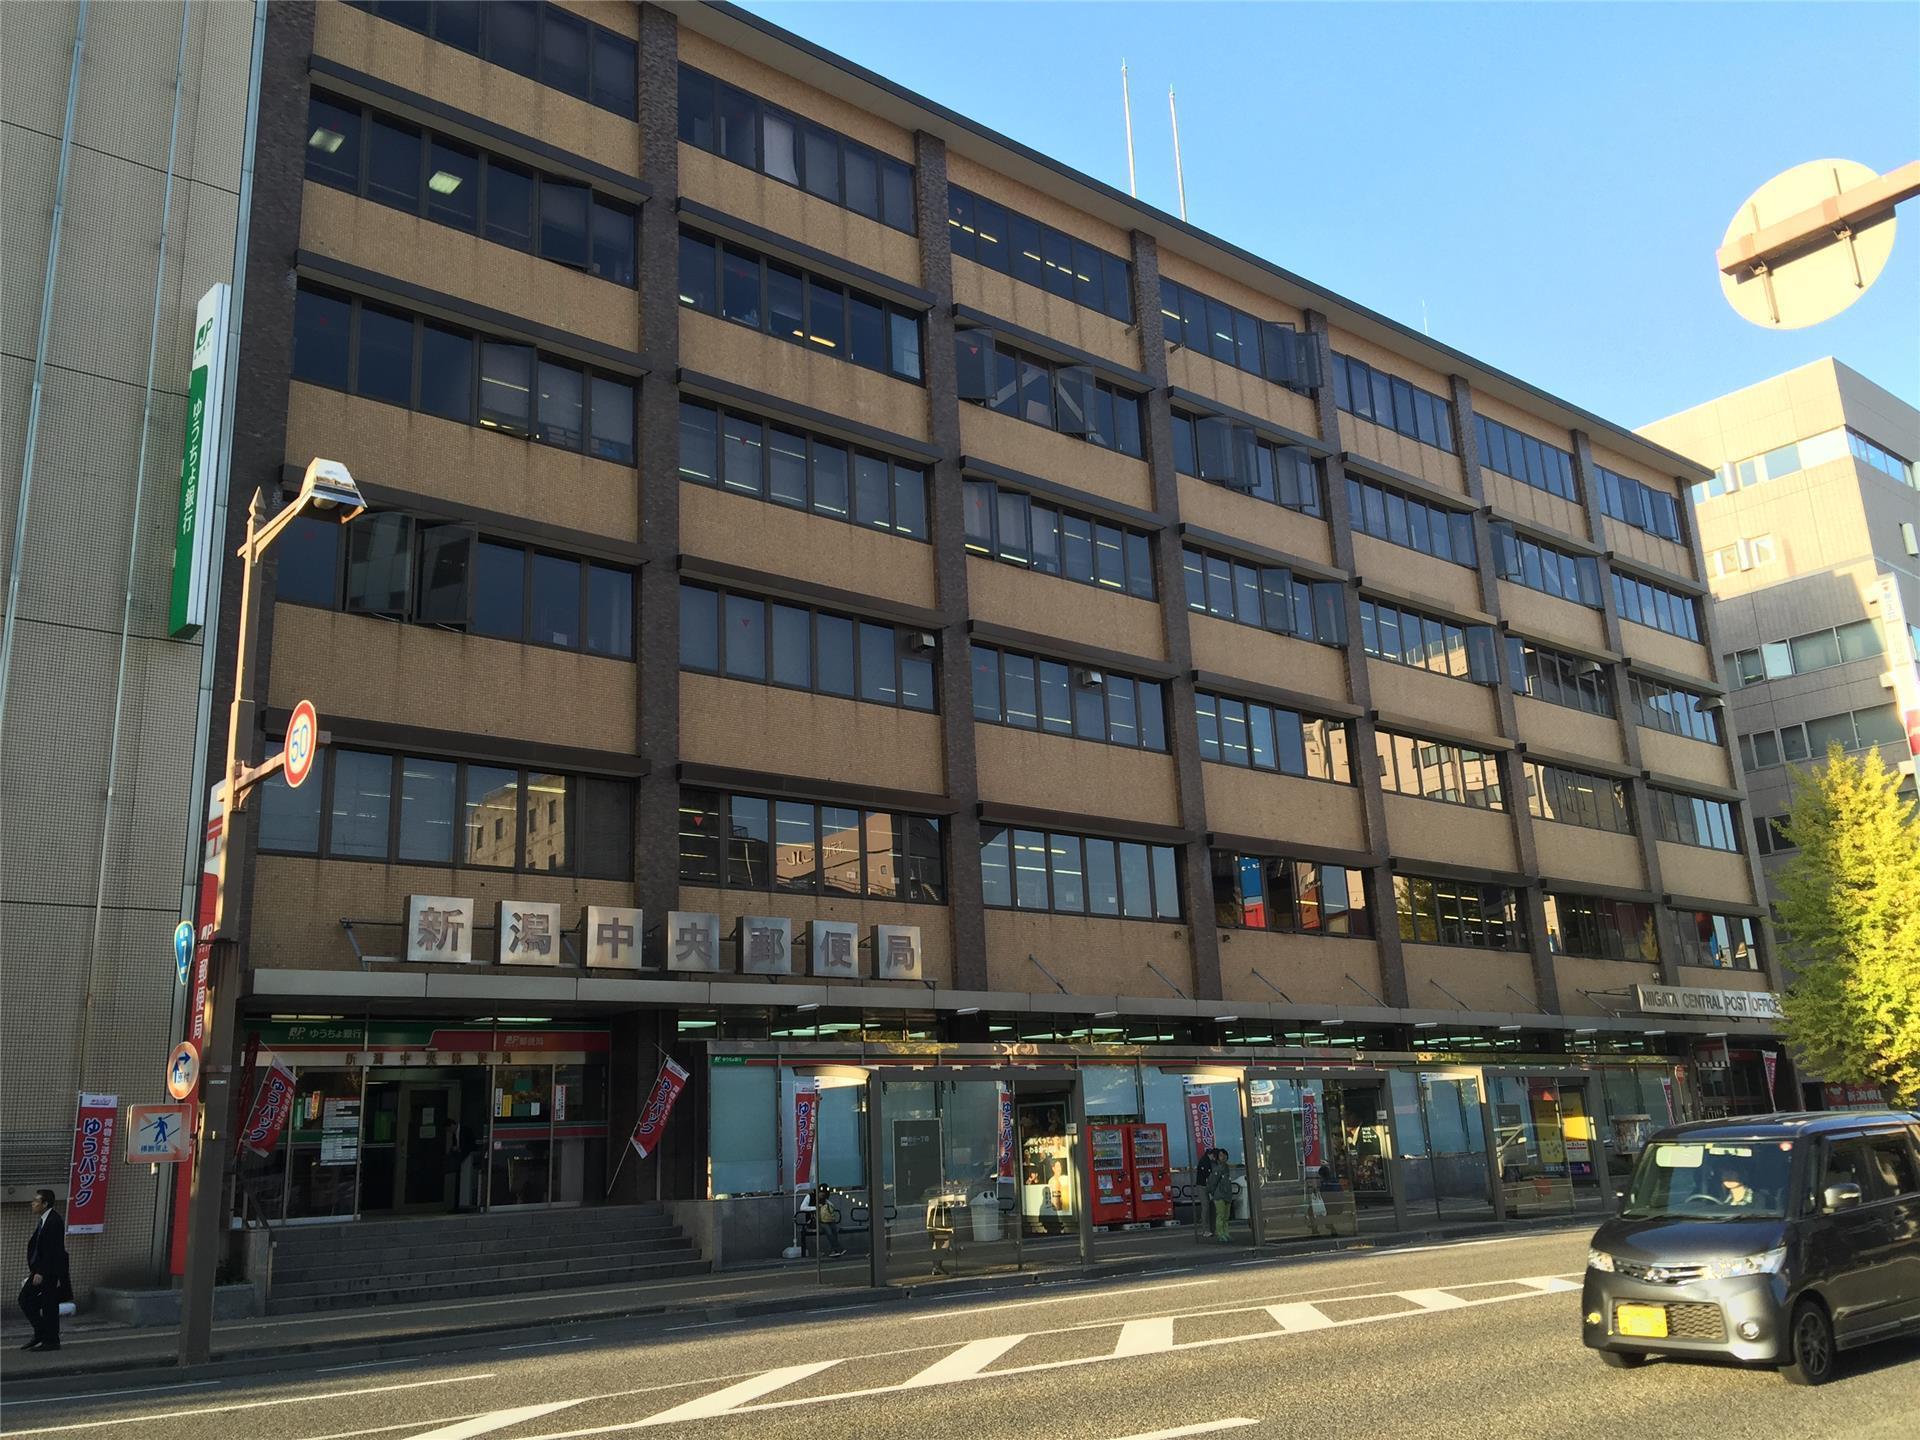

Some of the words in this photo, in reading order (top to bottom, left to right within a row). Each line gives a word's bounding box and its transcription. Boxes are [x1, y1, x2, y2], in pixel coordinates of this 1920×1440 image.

[182, 398, 203, 535] ゆうちょ銀行
[290, 724, 308, 764] 50
[180, 940, 187, 963] 7
[416, 906, 916, 971] 新潟中央郵便局
[1642, 989, 1679, 1008] NIIGATA
[1682, 992, 1724, 1010] CENTRAL
[1726, 994, 1747, 1013] POST
[250, 1077, 286, 1142] ゆうパック
[75, 1116, 102, 1208] ゆうパック
